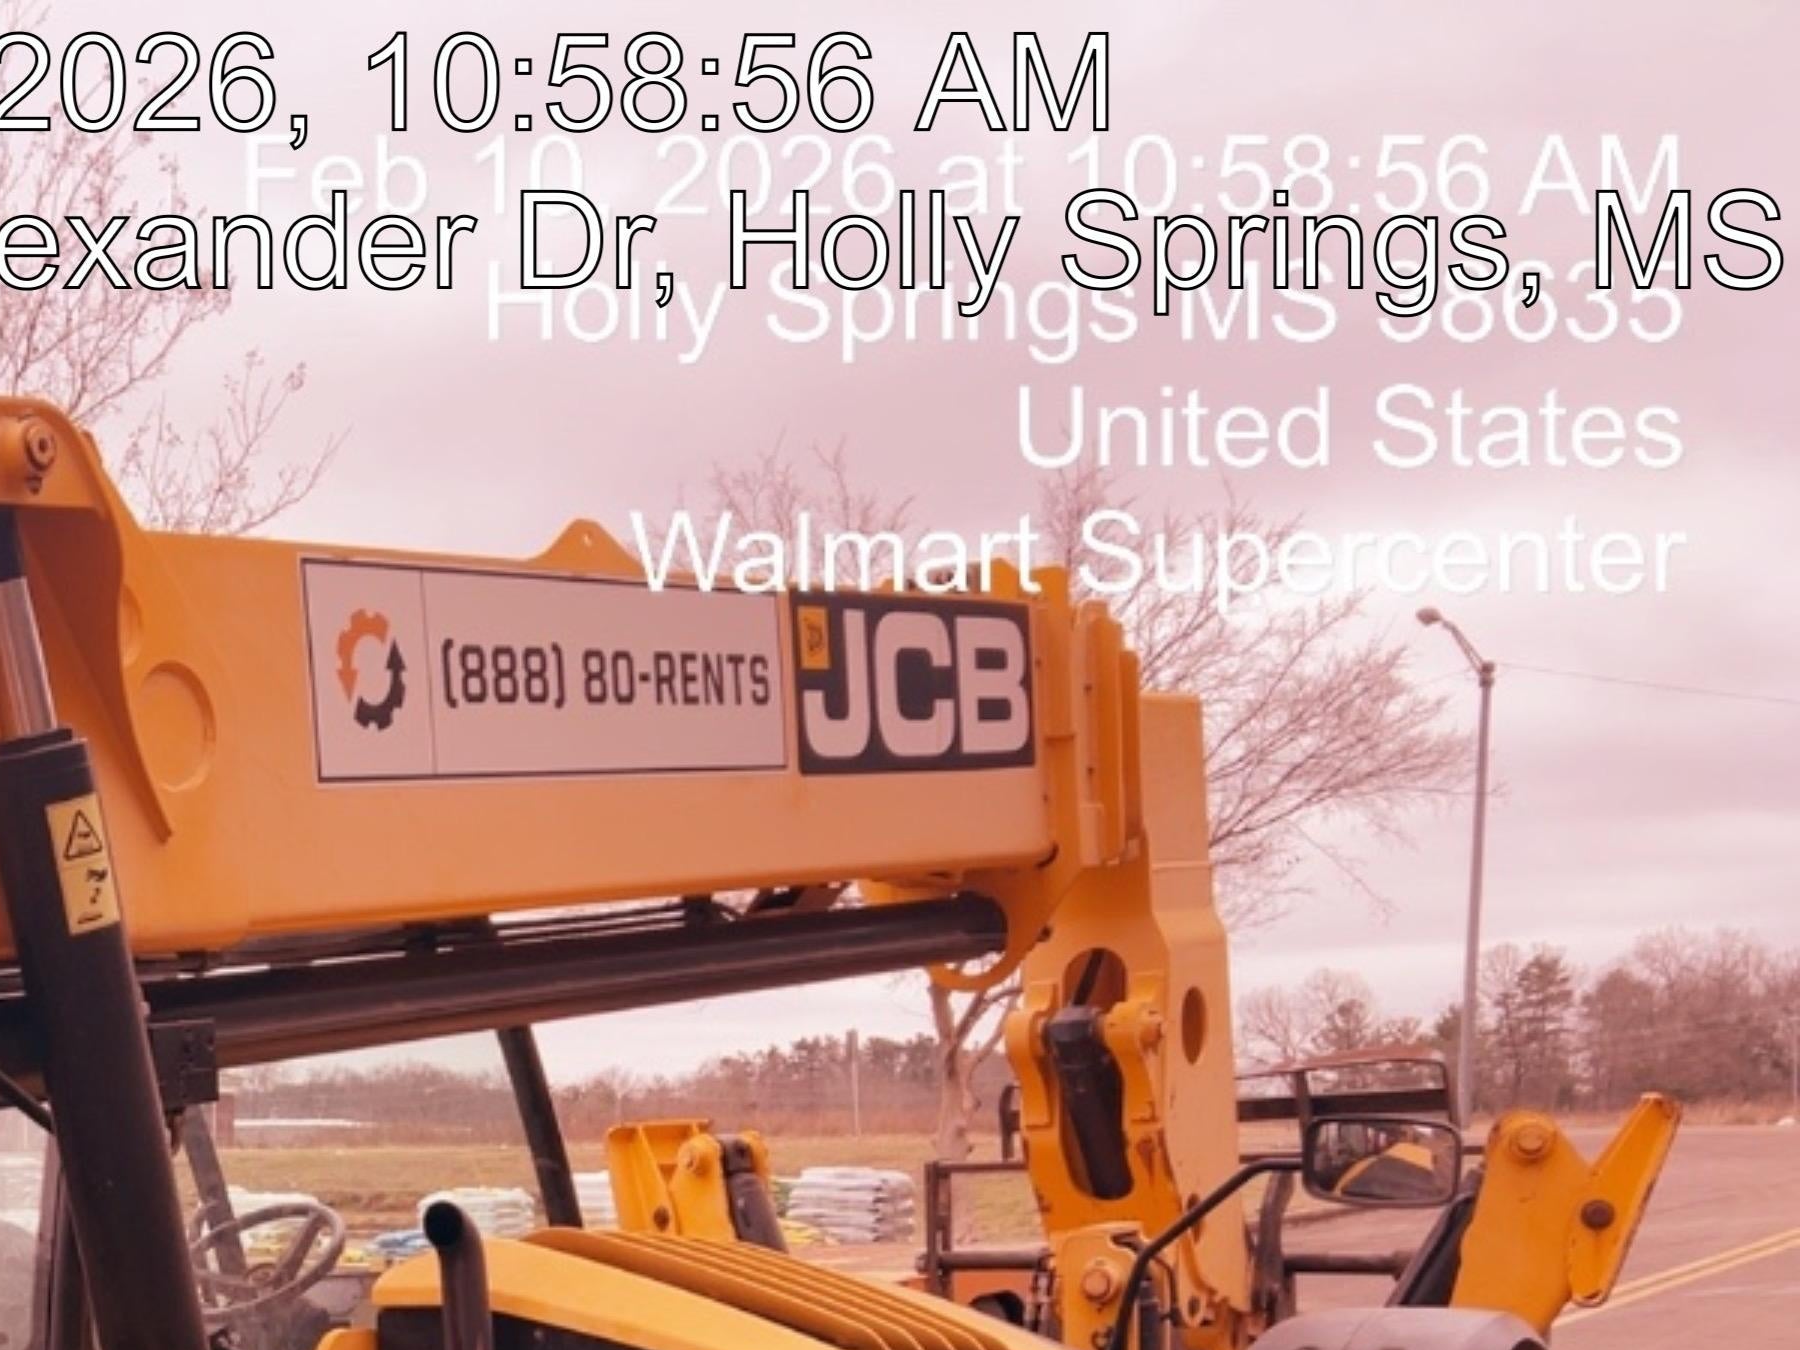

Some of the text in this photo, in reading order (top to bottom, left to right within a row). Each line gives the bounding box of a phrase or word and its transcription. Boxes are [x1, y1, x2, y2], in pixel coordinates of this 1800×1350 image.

[440, 636, 771, 710] (888) 80-RENTS
[800, 606, 1031, 759] JCB
